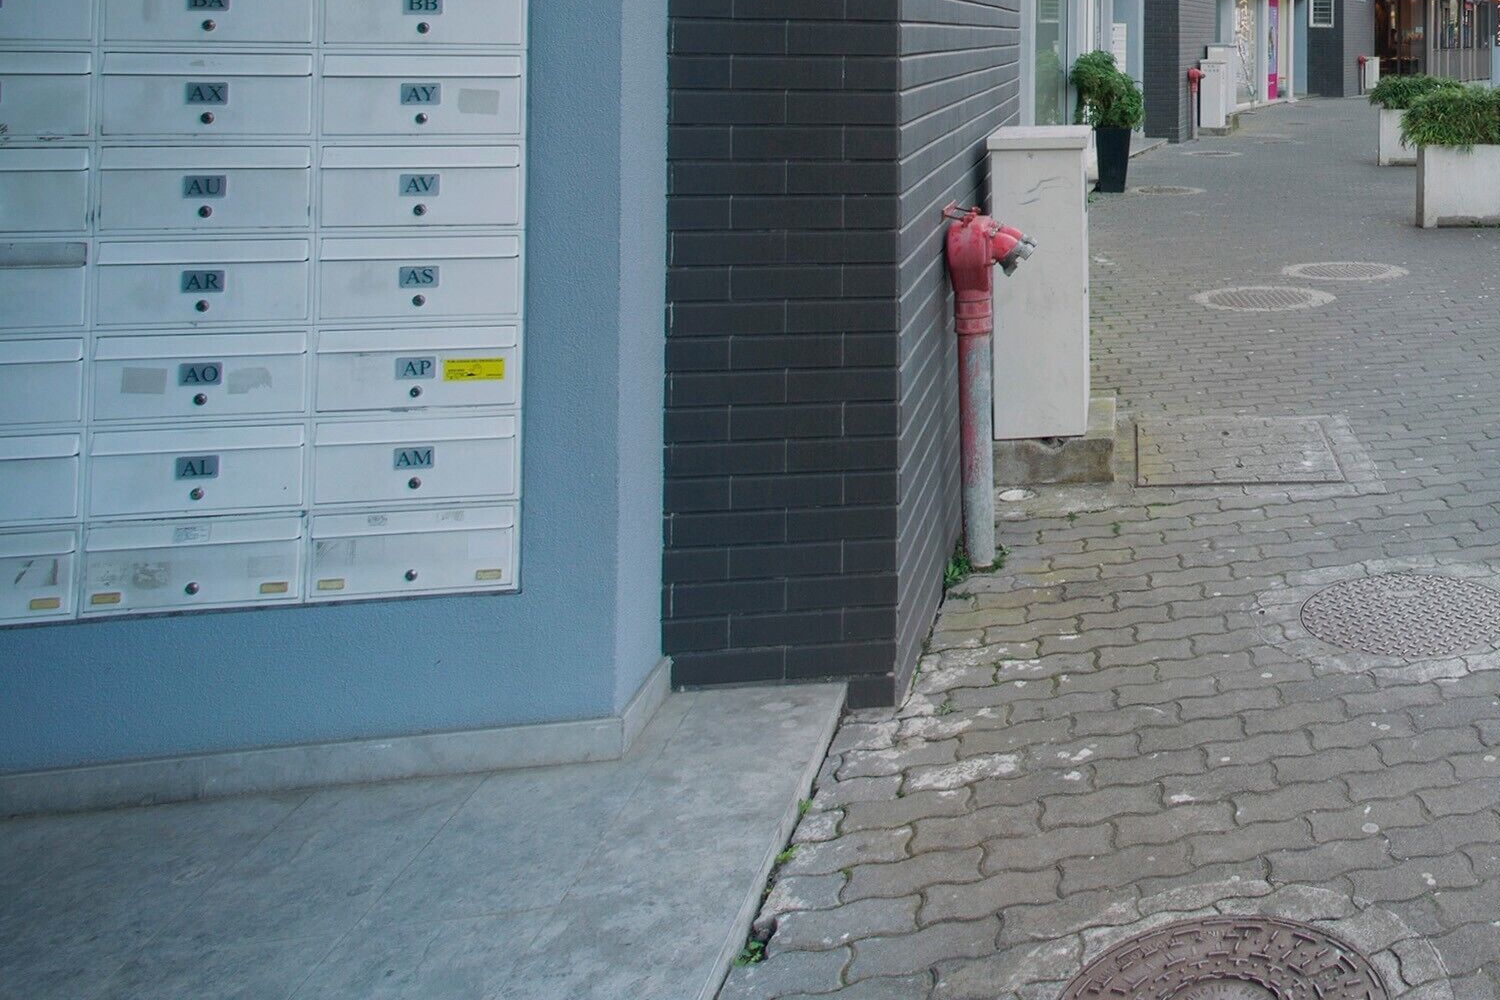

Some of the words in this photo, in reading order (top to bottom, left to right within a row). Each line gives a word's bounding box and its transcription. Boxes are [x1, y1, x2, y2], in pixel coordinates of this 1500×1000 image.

[191, 86, 223, 103] AX
[406, 86, 437, 103] AY
[187, 178, 220, 196] AU
[405, 177, 435, 194] AV
[185, 273, 220, 291] AR
[405, 269, 435, 285] AS
[184, 366, 219, 383] AO
[403, 360, 432, 377] AP
[181, 459, 214, 478] AL
[396, 450, 433, 468] AM
